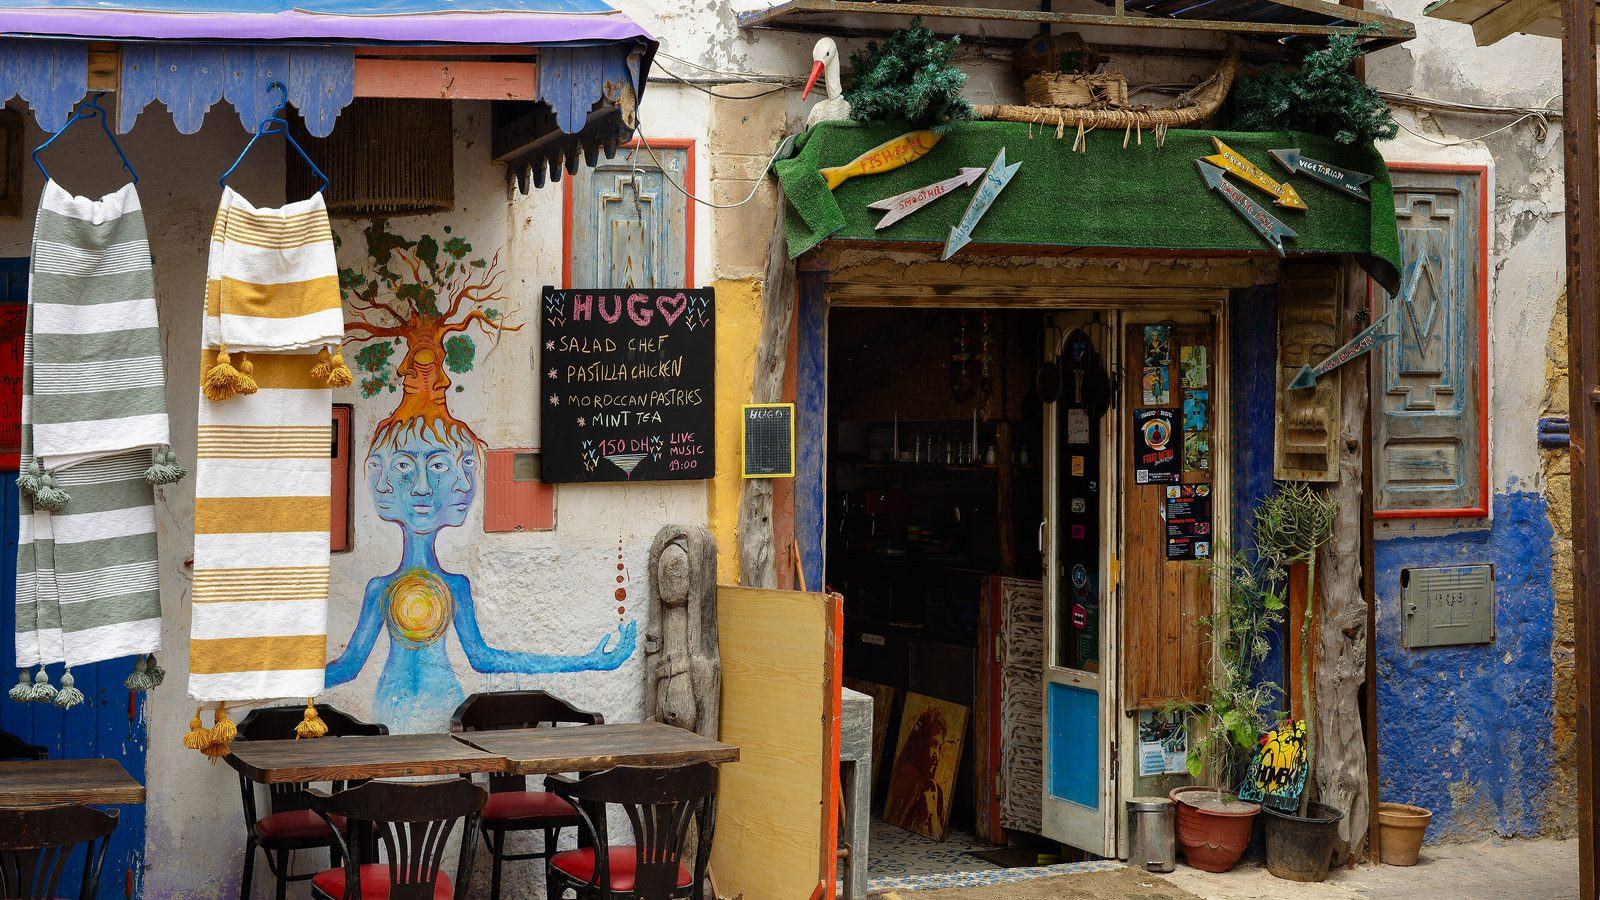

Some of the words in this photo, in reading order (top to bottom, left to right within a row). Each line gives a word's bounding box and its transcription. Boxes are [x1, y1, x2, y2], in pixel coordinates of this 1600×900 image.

[860, 148, 893, 173] FISH
[1299, 159, 1345, 181] VEGETARIAN
[898, 186, 945, 210] SMOOTHIES
[559, 335, 616, 354] SALAD
[628, 334, 669, 353] CHEF
[567, 361, 627, 384] PASTILLA
[631, 355, 683, 380] CHICKEN
[568, 393, 648, 409] MOROCCAN
[649, 388, 703, 407] PASTRIES
[592, 410, 631, 428] MINT
[636, 411, 663, 426] TEA
[750, 409, 783, 420] HUGO
[599, 439, 626, 456] 150
[630, 436, 649, 452] DH
[670, 432, 696, 444] LIVE
[669, 445, 705, 456] MUSIC
[669, 459, 698, 472] 19:00
